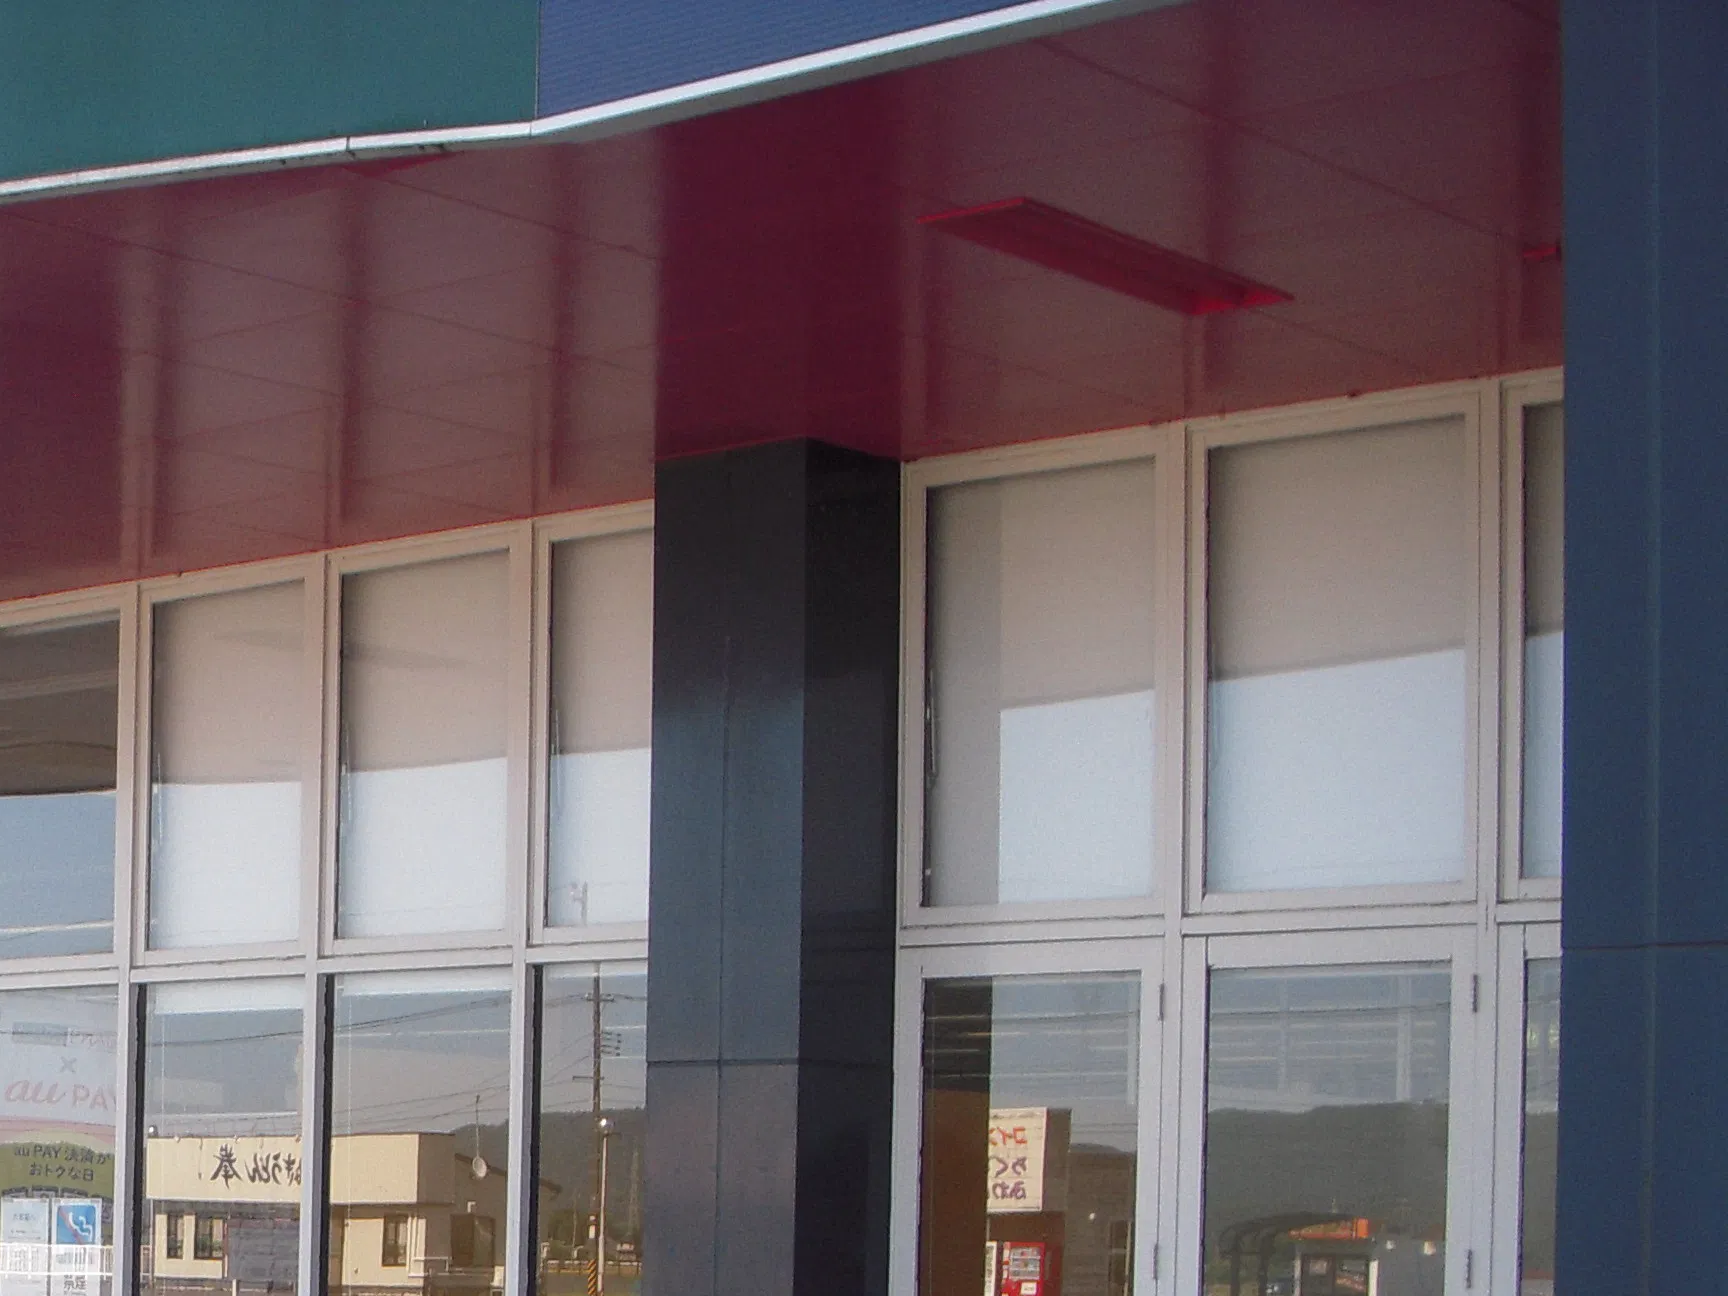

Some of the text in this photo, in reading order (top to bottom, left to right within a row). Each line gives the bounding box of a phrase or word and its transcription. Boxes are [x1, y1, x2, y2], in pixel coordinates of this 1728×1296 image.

[33, 1144, 61, 1159] PAY
[28, 1161, 95, 1182] おトクな日
